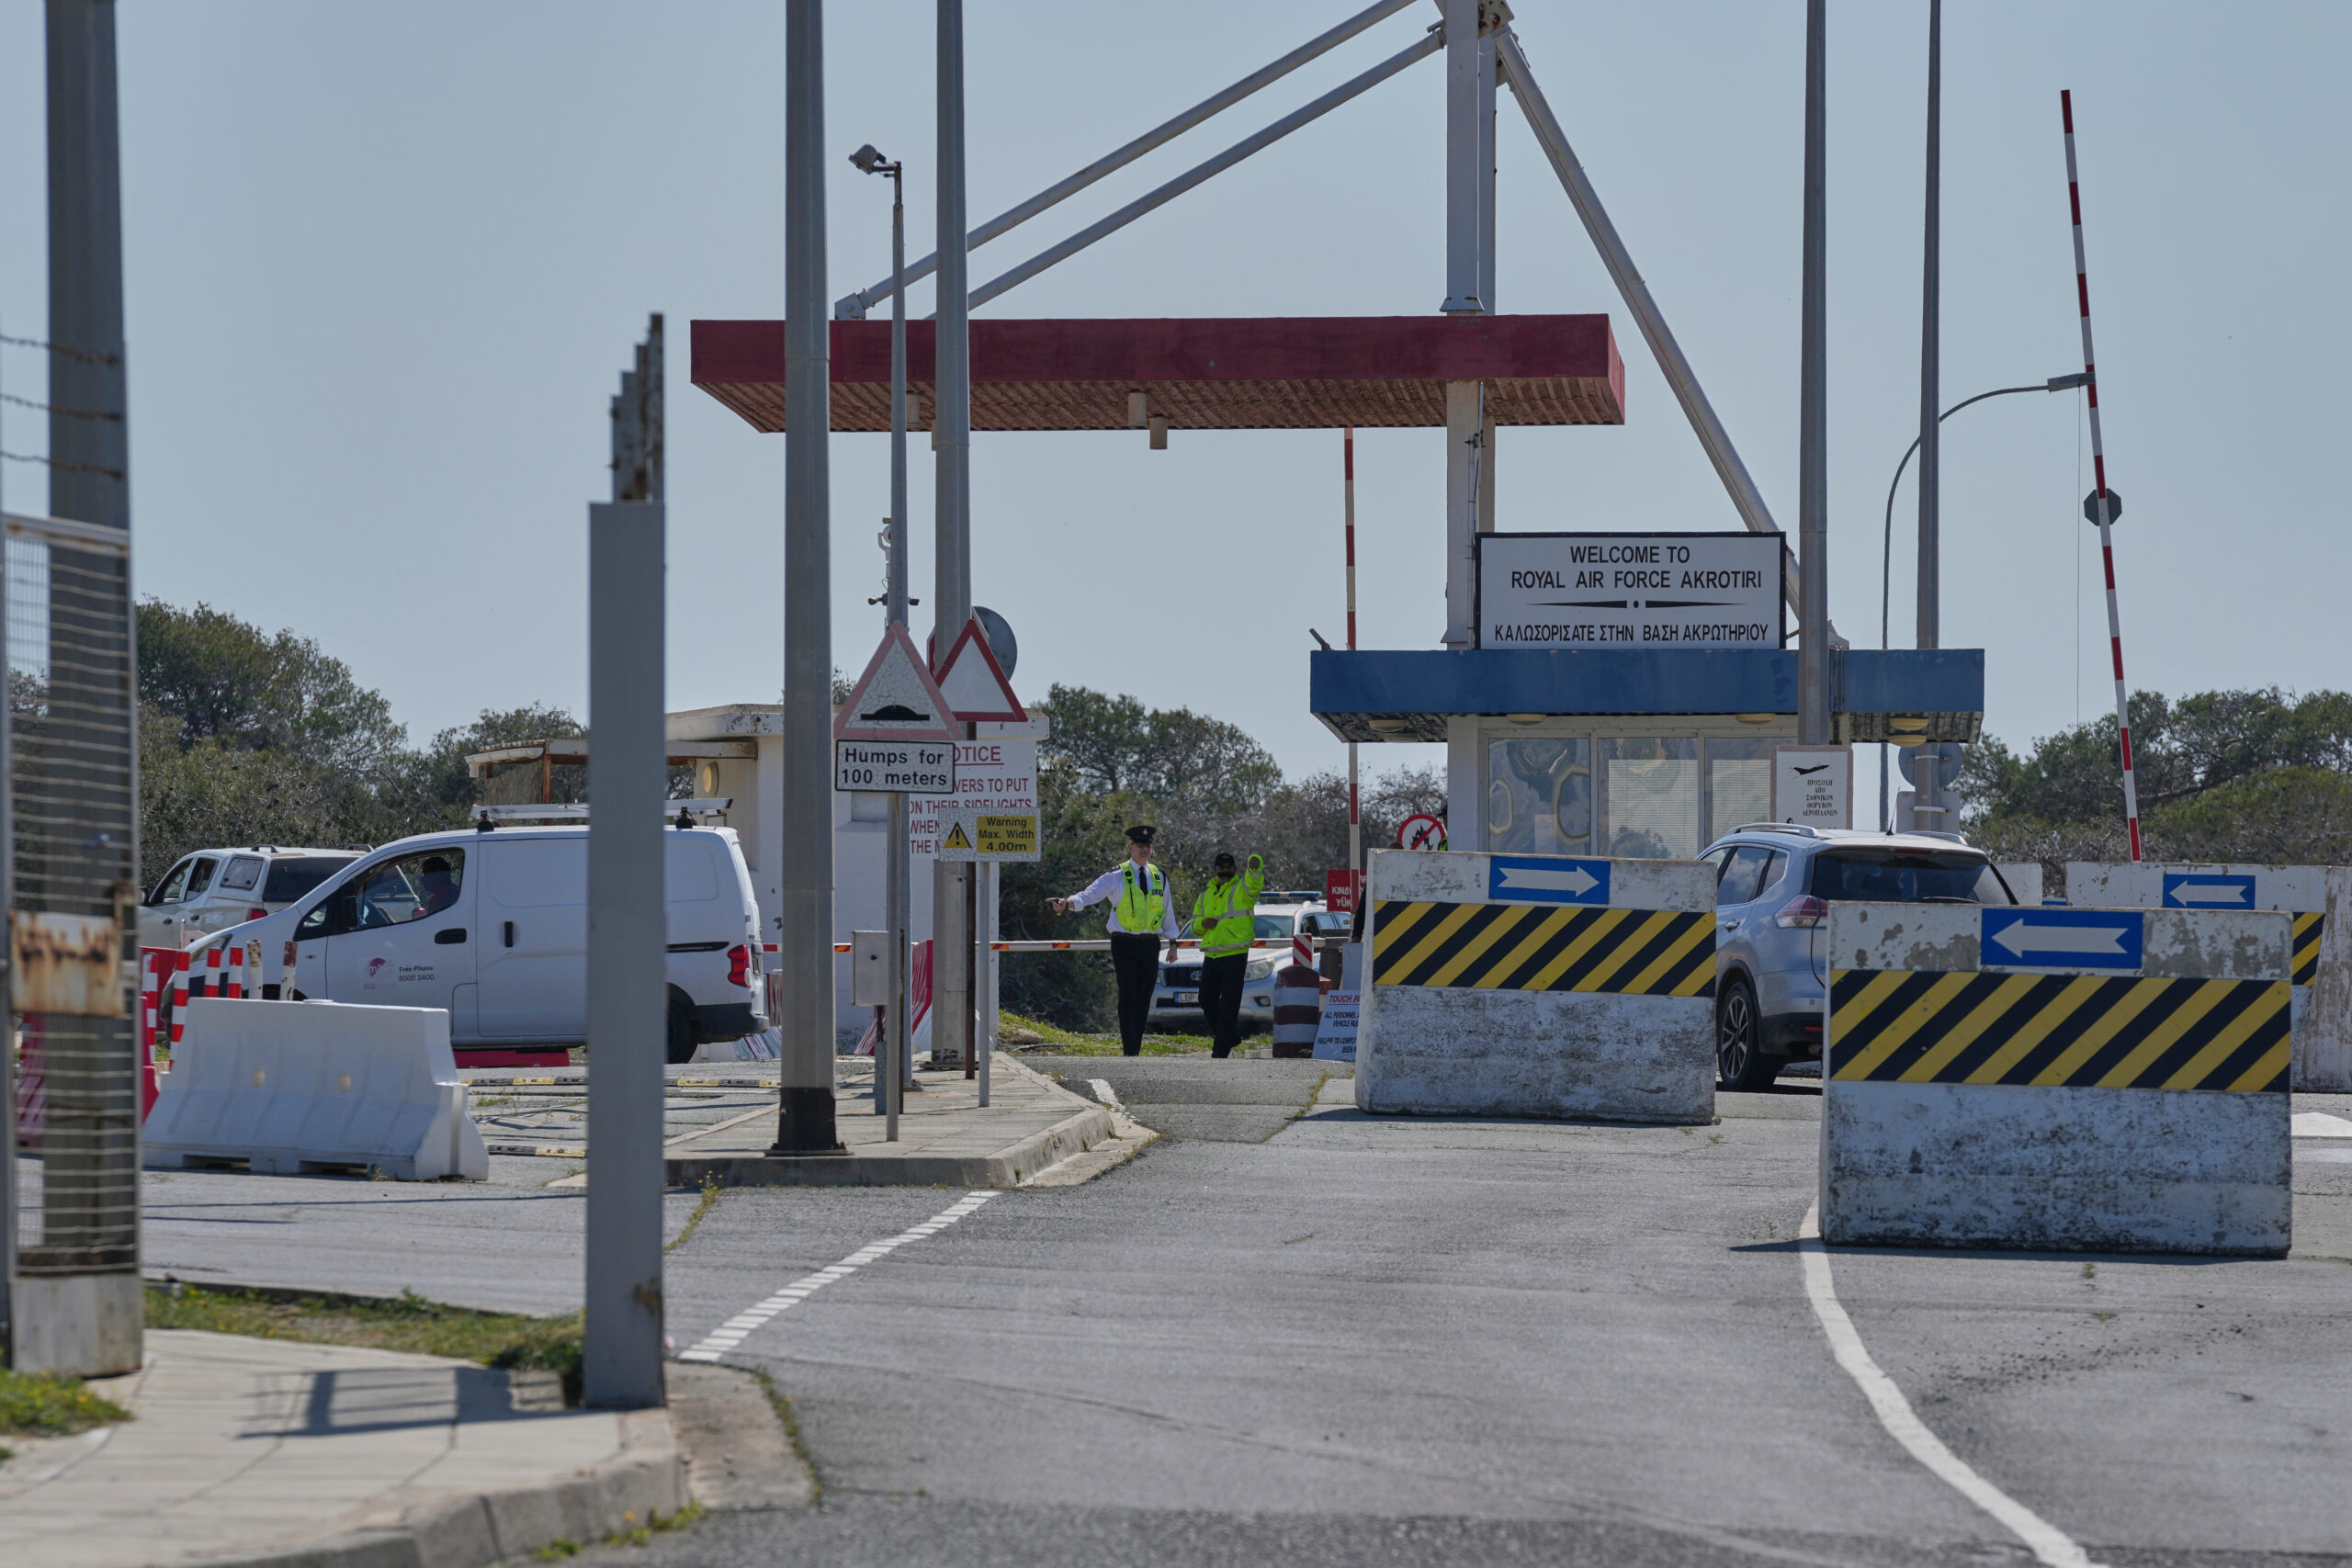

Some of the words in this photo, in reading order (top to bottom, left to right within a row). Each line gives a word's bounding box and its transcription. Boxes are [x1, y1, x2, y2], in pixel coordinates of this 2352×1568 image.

[1570, 546, 1660, 563] WELCOME
[1666, 546, 1690, 563] TO
[1511, 570, 1566, 589] ROYAL
[1576, 570, 1604, 588] AIR
[1614, 570, 1671, 588] FORCE
[1680, 570, 1762, 588] AKROTIRI
[1495, 624, 1595, 642] ΚΑΛΩΣΟΡΙΣΑΤΕ
[1599, 624, 1634, 641] ΣΤΗΝ
[1643, 624, 1679, 641] ΒΑΣΗ
[1682, 623, 1770, 641] ΑΚΡΩΤΗΡΙΟΥ
[844, 748, 908, 767] Humps
[919, 750, 944, 764] for
[955, 746, 1001, 762] OTICE
[842, 768, 873, 784] 100
[885, 772, 947, 785] meters
[954, 778, 984, 793] VERS
[988, 778, 1003, 792] TO
[1006, 777, 1029, 792] PUT
[986, 817, 1027, 828] Warning
[978, 829, 1001, 839] Max.
[1006, 829, 1035, 839] Width
[910, 840, 932, 853] THE
[986, 841, 1027, 852] 4.00m
[1329, 995, 1352, 1003] TOUCH
